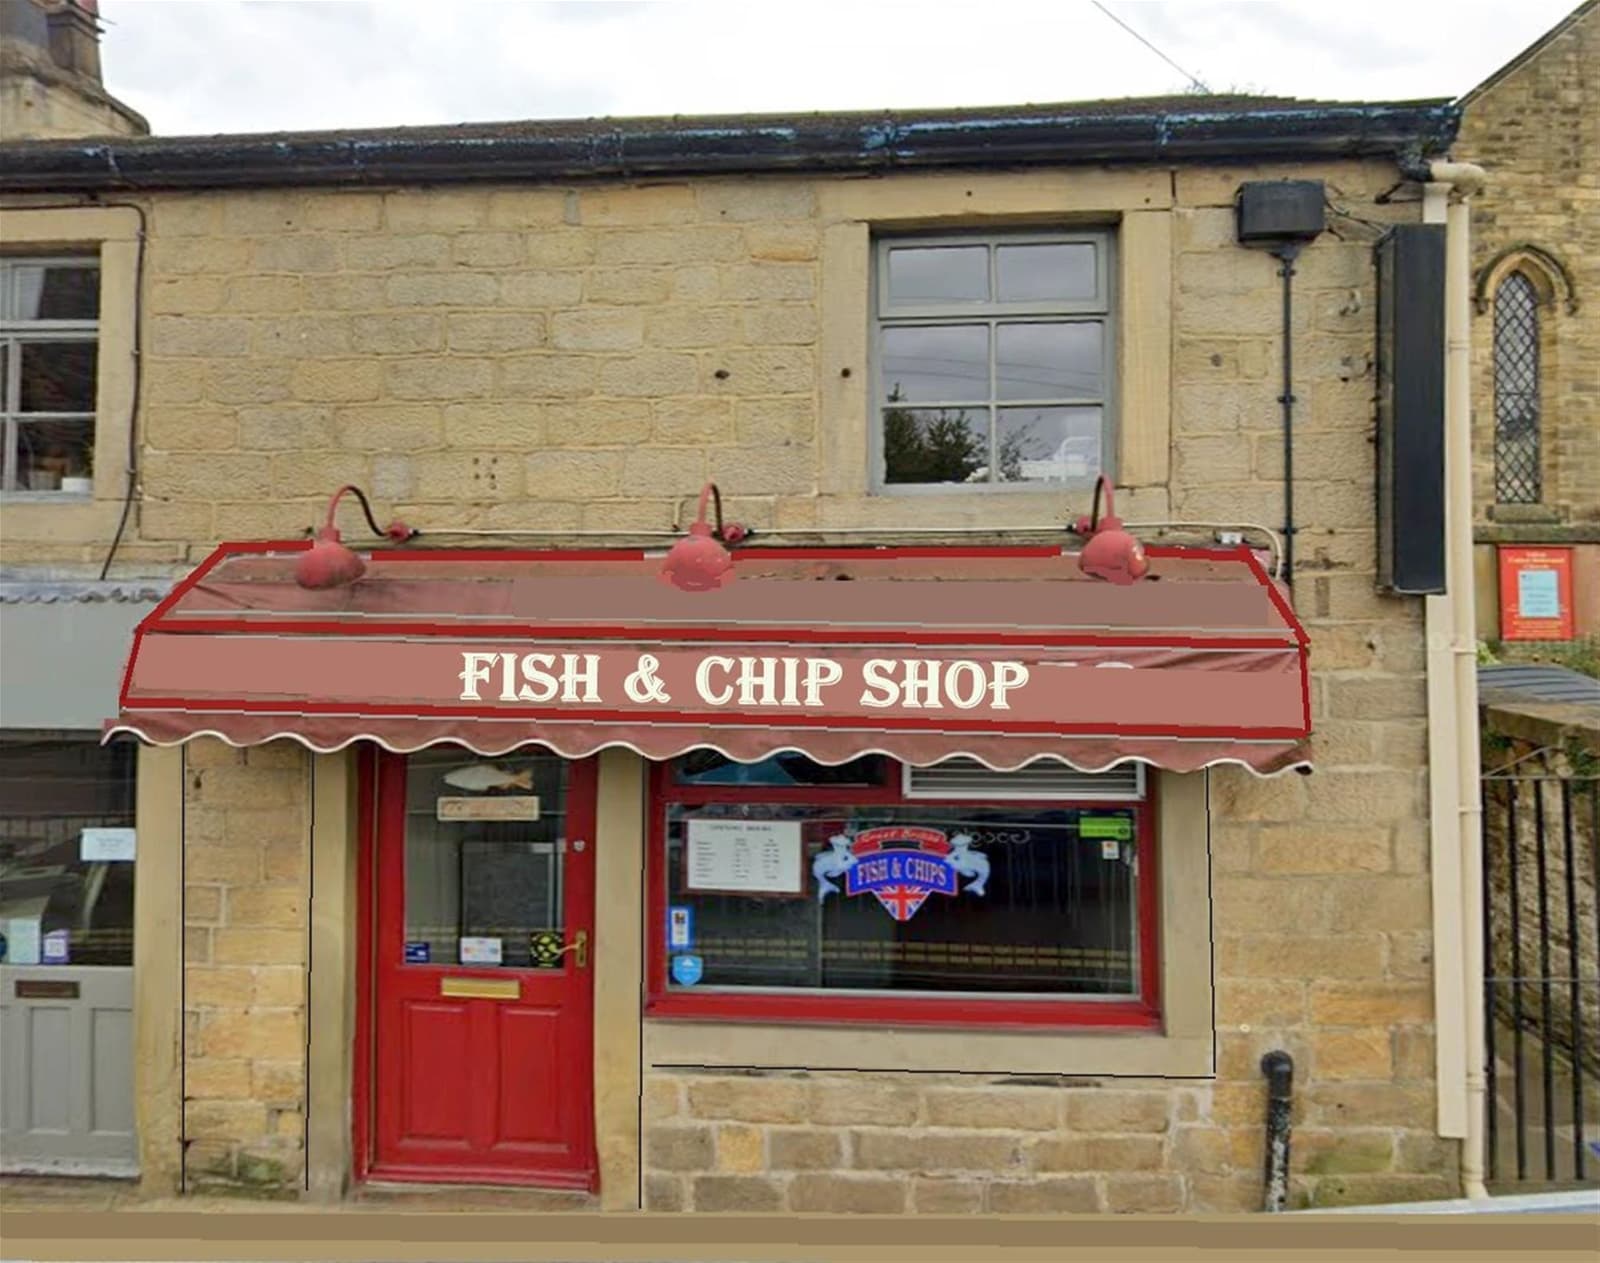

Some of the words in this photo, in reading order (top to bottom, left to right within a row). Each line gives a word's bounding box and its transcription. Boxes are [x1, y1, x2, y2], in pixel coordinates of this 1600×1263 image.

[458, 651, 602, 702] FISH
[624, 653, 671, 704] &
[695, 655, 843, 707] CHIP
[859, 658, 1030, 710] SHOP
[857, 858, 889, 886] FISH
[891, 857, 902, 879] &
[905, 857, 947, 887] CHIPS
